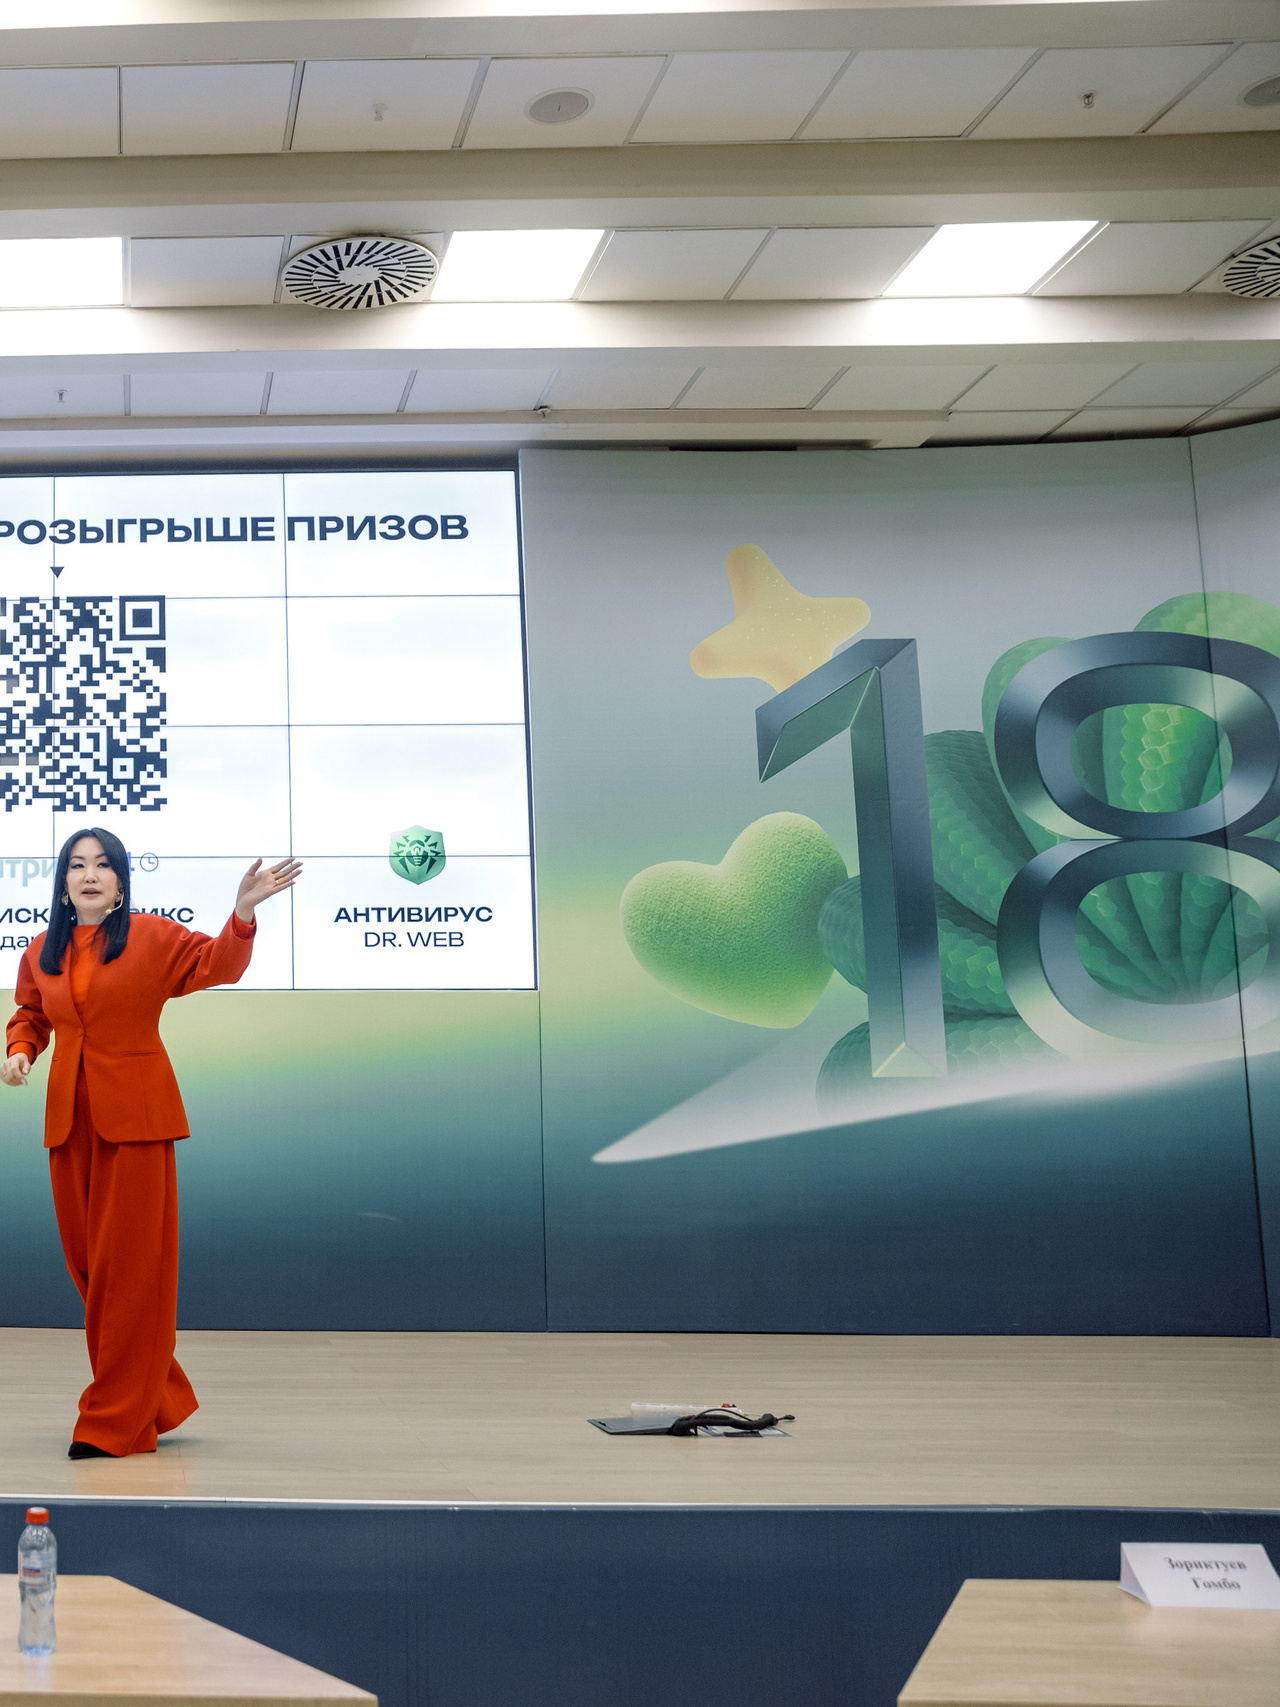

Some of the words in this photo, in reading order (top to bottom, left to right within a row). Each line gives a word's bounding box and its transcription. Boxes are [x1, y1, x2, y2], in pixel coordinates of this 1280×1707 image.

[286, 514, 470, 542] ПРИЗОВ
[754, 630, 1280, 1080] 18
[333, 906, 494, 923] АНТИВИРУС
[363, 931, 403, 948] DR.
[407, 931, 465, 948] WEB
[1162, 1556, 1248, 1573] Зориктуев
[1190, 1577, 1242, 1591] Гомбо
